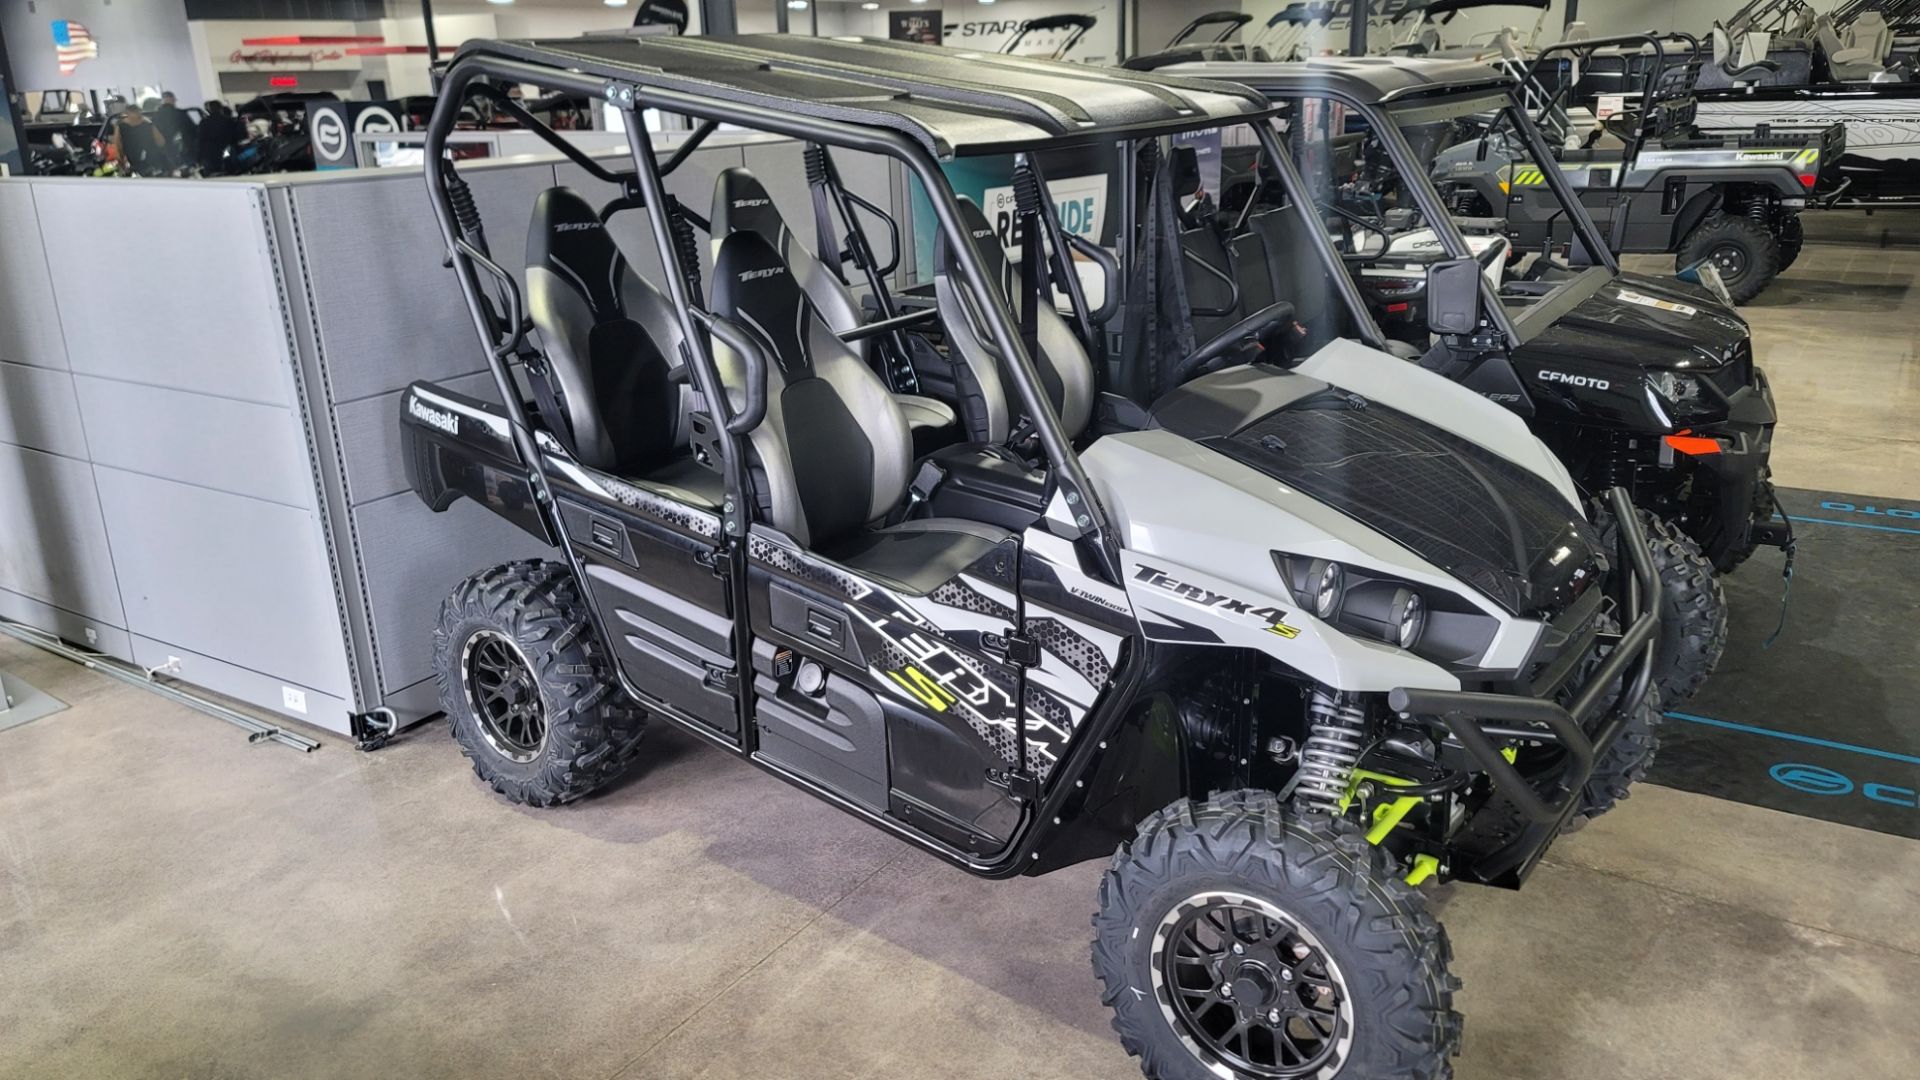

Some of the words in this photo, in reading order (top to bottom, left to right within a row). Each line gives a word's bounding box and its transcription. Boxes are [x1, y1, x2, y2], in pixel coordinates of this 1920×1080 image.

[1736, 152, 1783, 161] Kawasaki
[1056, 197, 1093, 233] IDE
[1538, 370, 1609, 390] CFMOTO
[1488, 393, 1521, 402] EPS
[409, 395, 459, 435] Kawasaki
[1134, 563, 1289, 624] TERYX4
[1261, 622, 1302, 639] S
